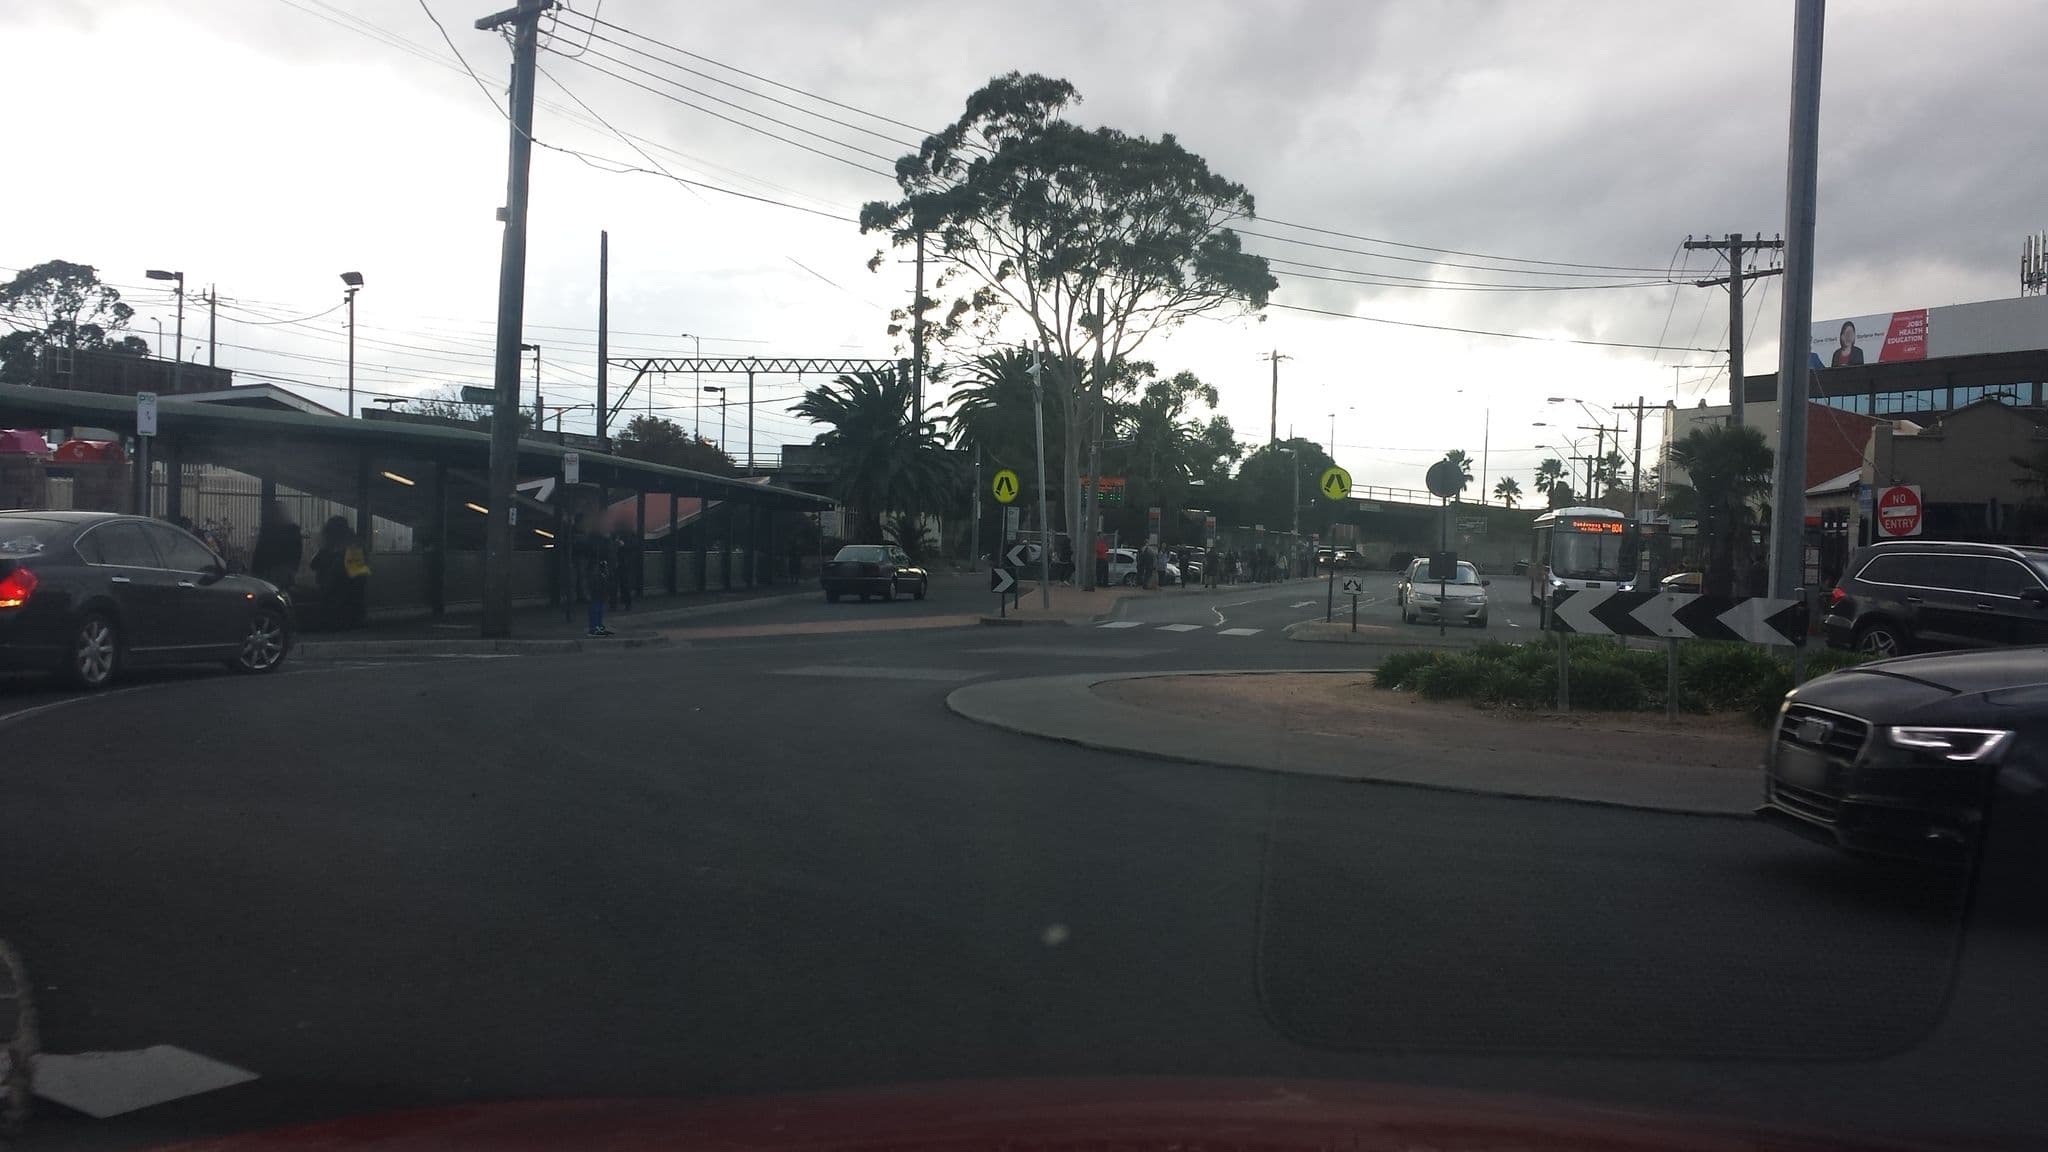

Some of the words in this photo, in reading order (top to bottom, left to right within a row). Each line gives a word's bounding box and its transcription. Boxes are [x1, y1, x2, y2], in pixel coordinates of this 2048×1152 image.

[1907, 320, 1923, 328] JOBS
[1887, 335, 1923, 345] EDUCATION
[1892, 494, 1906, 504] NO
[1885, 519, 1914, 529] ENTRY
